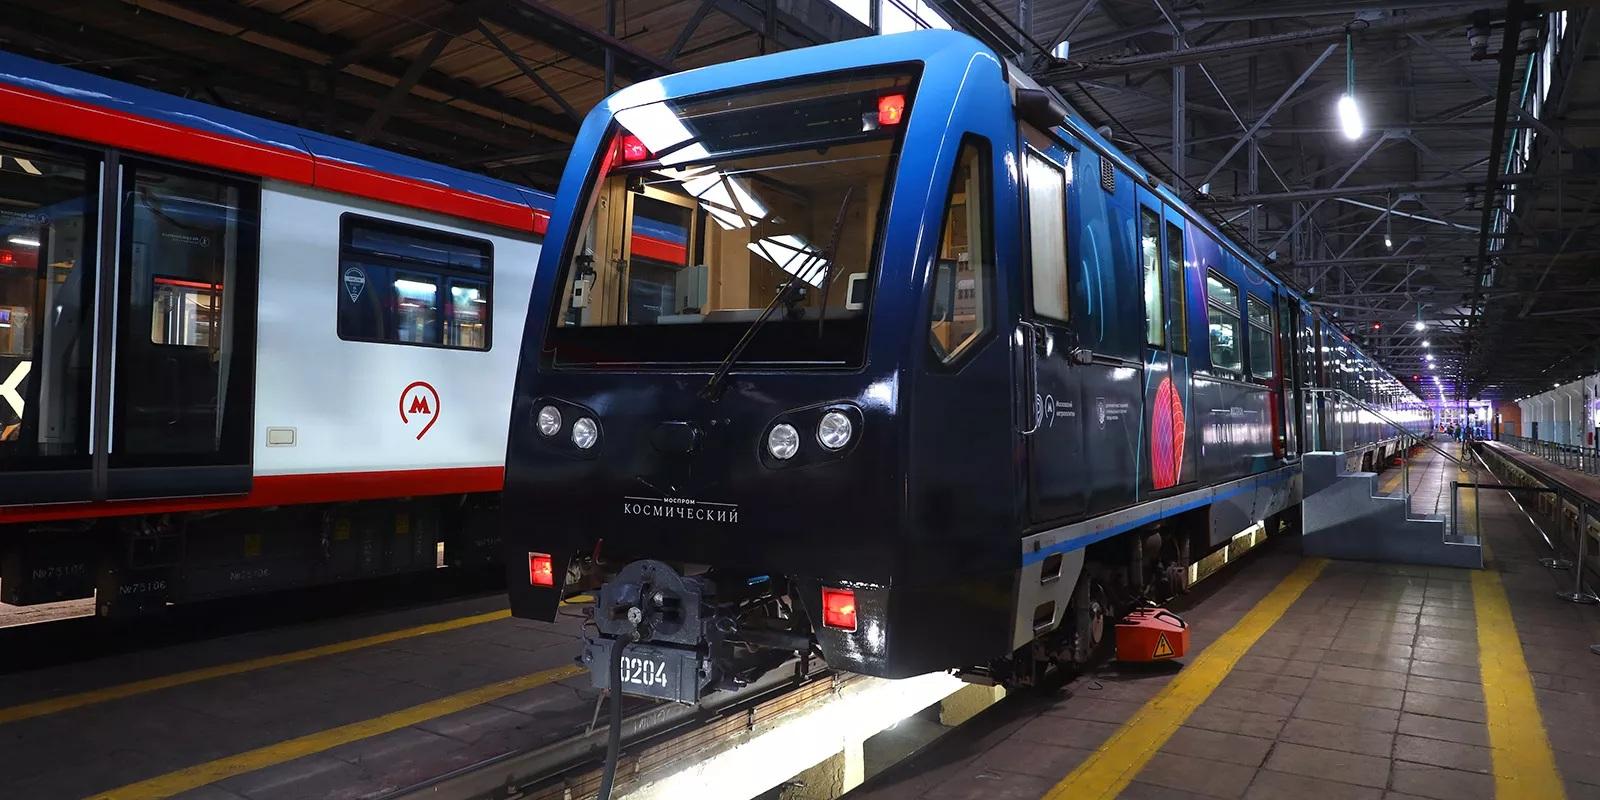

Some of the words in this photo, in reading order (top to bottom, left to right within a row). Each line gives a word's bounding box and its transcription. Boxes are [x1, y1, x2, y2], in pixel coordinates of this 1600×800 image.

[408, 395, 431, 414] М
[624, 503, 738, 523] КОСМИЧЕСКИЙ
[620, 656, 668, 688] 0204
